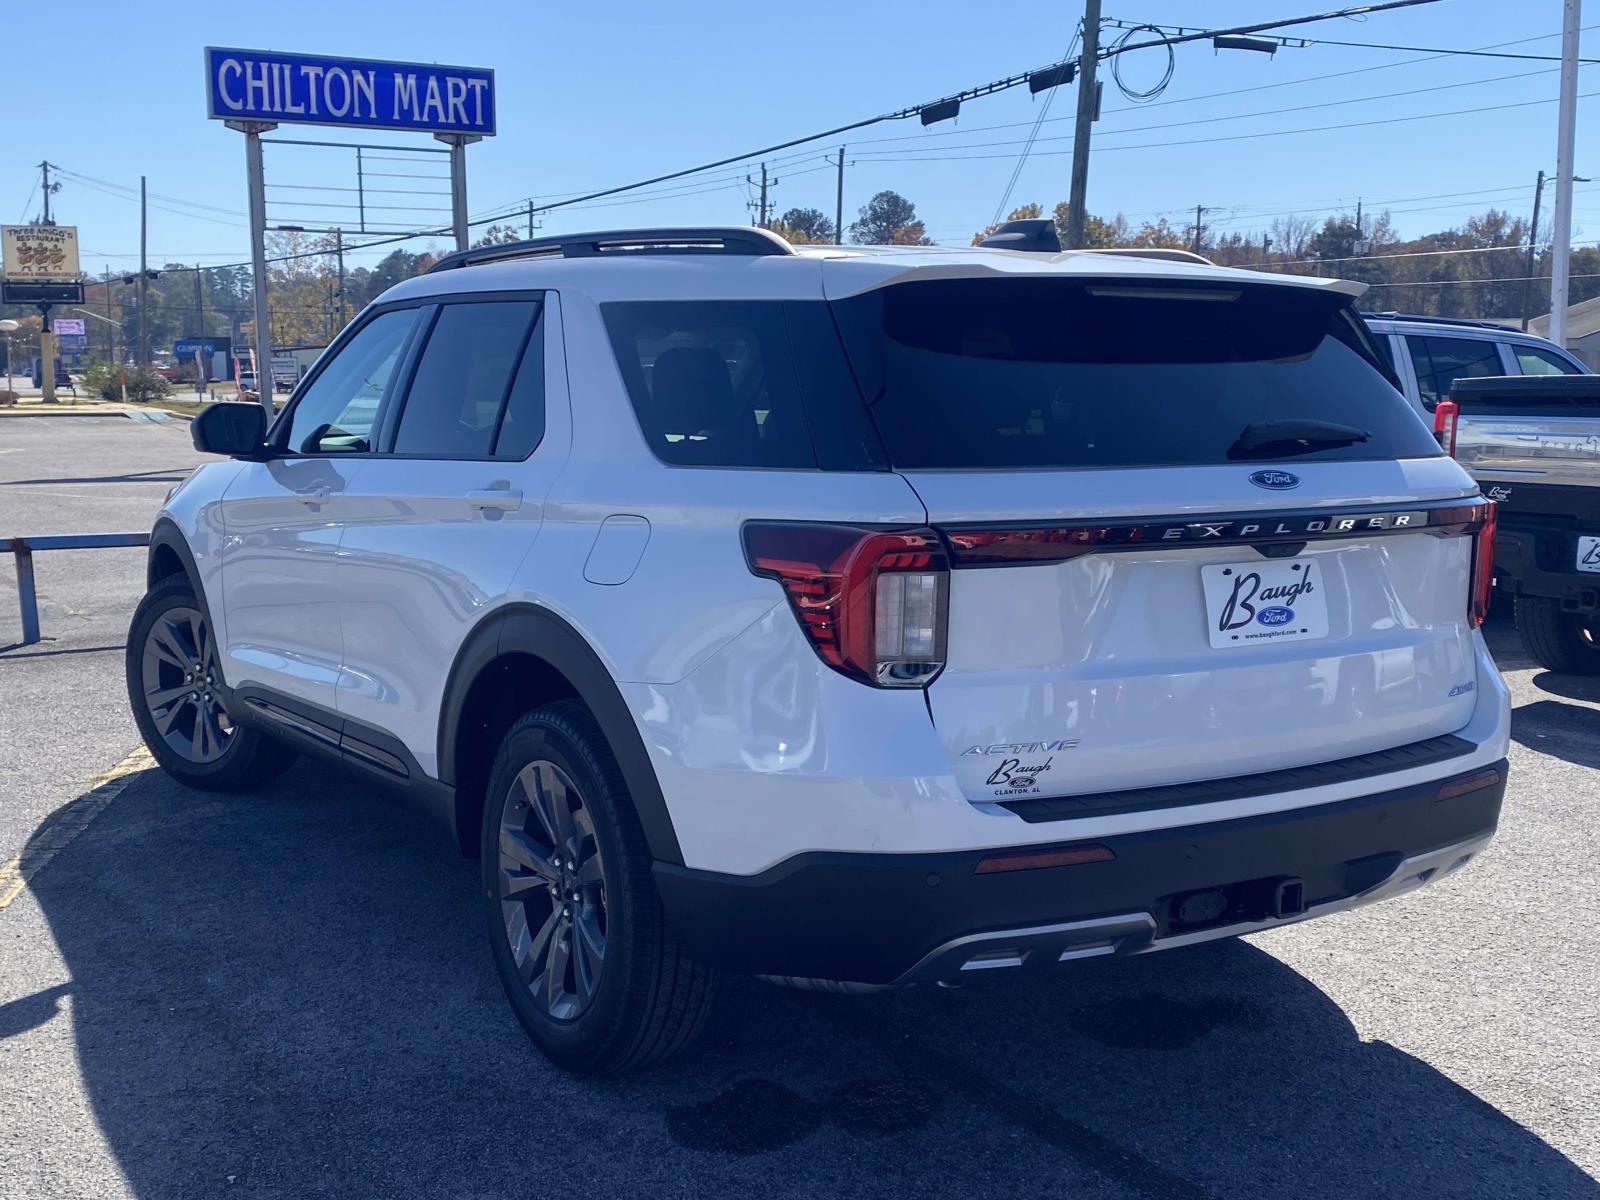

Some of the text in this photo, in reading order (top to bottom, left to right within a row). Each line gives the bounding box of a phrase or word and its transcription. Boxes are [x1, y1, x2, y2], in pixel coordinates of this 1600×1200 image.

[218, 58, 488, 125] CHILTON MART
[1162, 514, 1411, 540] EXPLORER
[1219, 564, 1313, 632] Baugh
[1263, 609, 1288, 624] Ford
[1245, 629, 1297, 639] www.baughford.com
[960, 739, 1081, 757] ACTIVE
[986, 757, 1053, 785] Baugh
